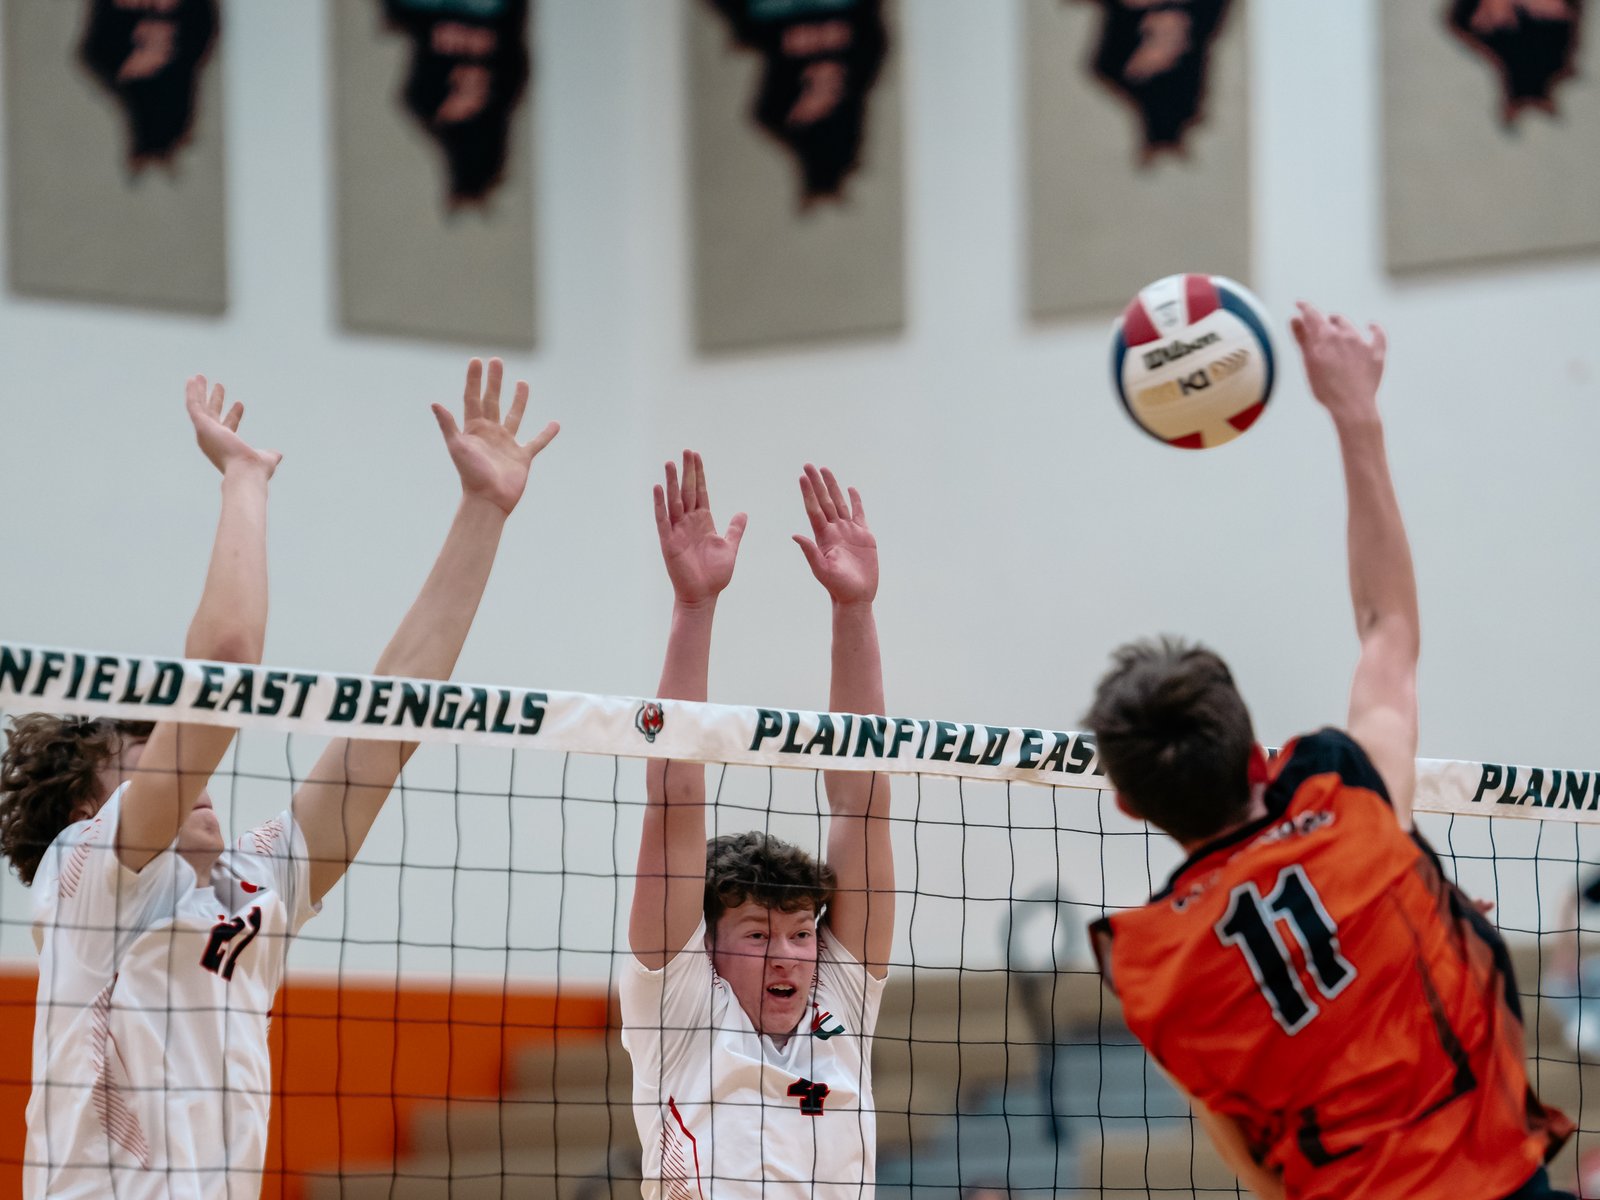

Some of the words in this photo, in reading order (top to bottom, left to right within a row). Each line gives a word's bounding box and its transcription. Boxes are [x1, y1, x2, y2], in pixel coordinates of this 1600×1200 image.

[0, 645, 184, 705] NFIELD
[190, 665, 318, 718] EAST
[325, 676, 548, 735] BENGALS
[749, 708, 1009, 767] PLAINFIELD
[1015, 728, 1105, 776] EAS
[1214, 864, 1357, 1036] 11
